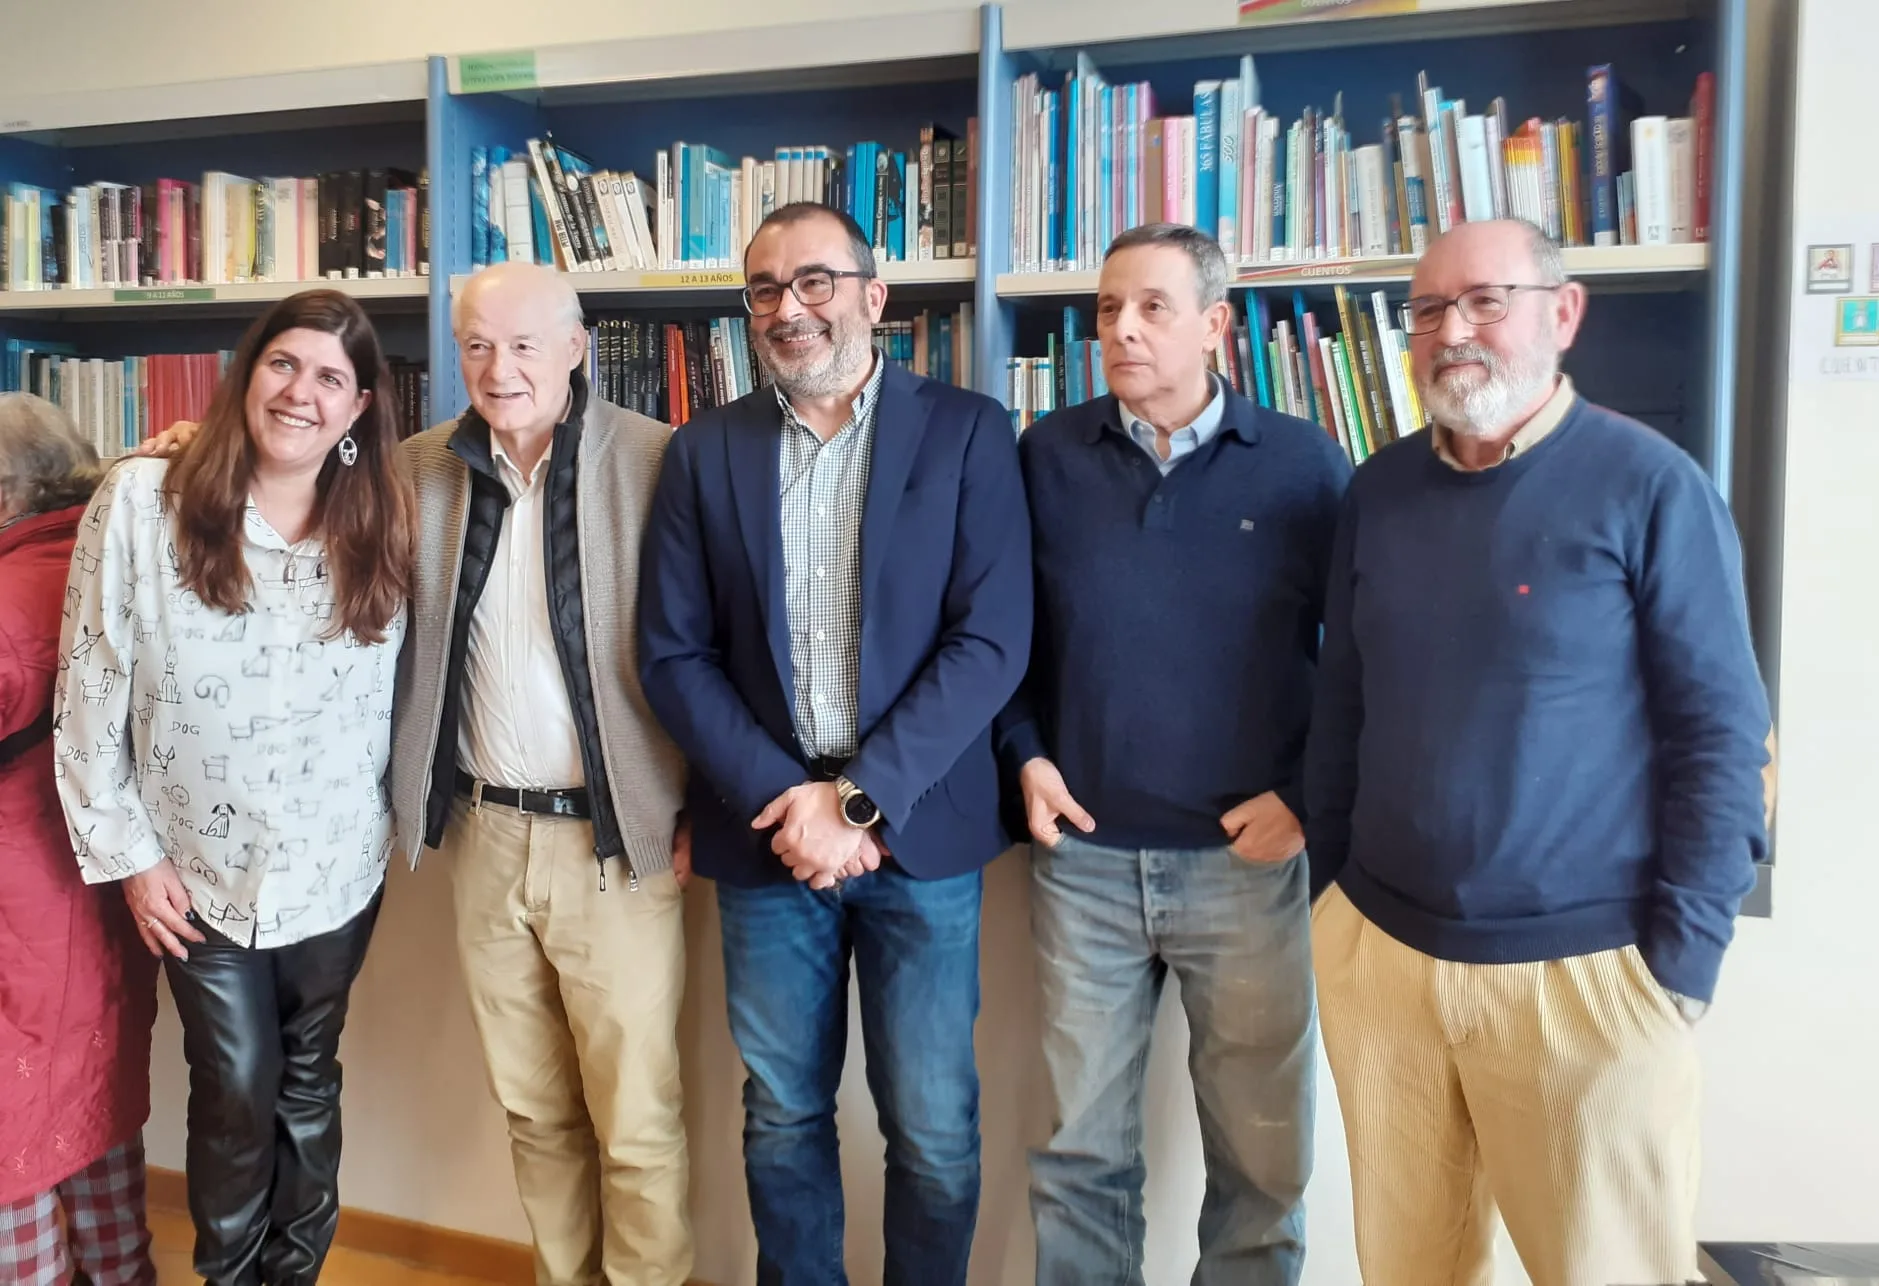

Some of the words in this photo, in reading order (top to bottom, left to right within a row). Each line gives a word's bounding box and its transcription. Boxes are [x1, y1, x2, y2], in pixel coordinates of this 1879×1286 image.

[554, 218, 563, 231] PAN
[558, 231, 569, 248] PETER
[680, 275, 690, 283] 12
[700, 274, 708, 282] 13
[710, 273, 734, 282] AÑOS
[1300, 265, 1352, 277] CUENTOS
[118, 604, 133, 619] DO
[168, 720, 200, 736] DOG
[62, 746, 90, 764] DOG
[170, 812, 194, 830] DOG
